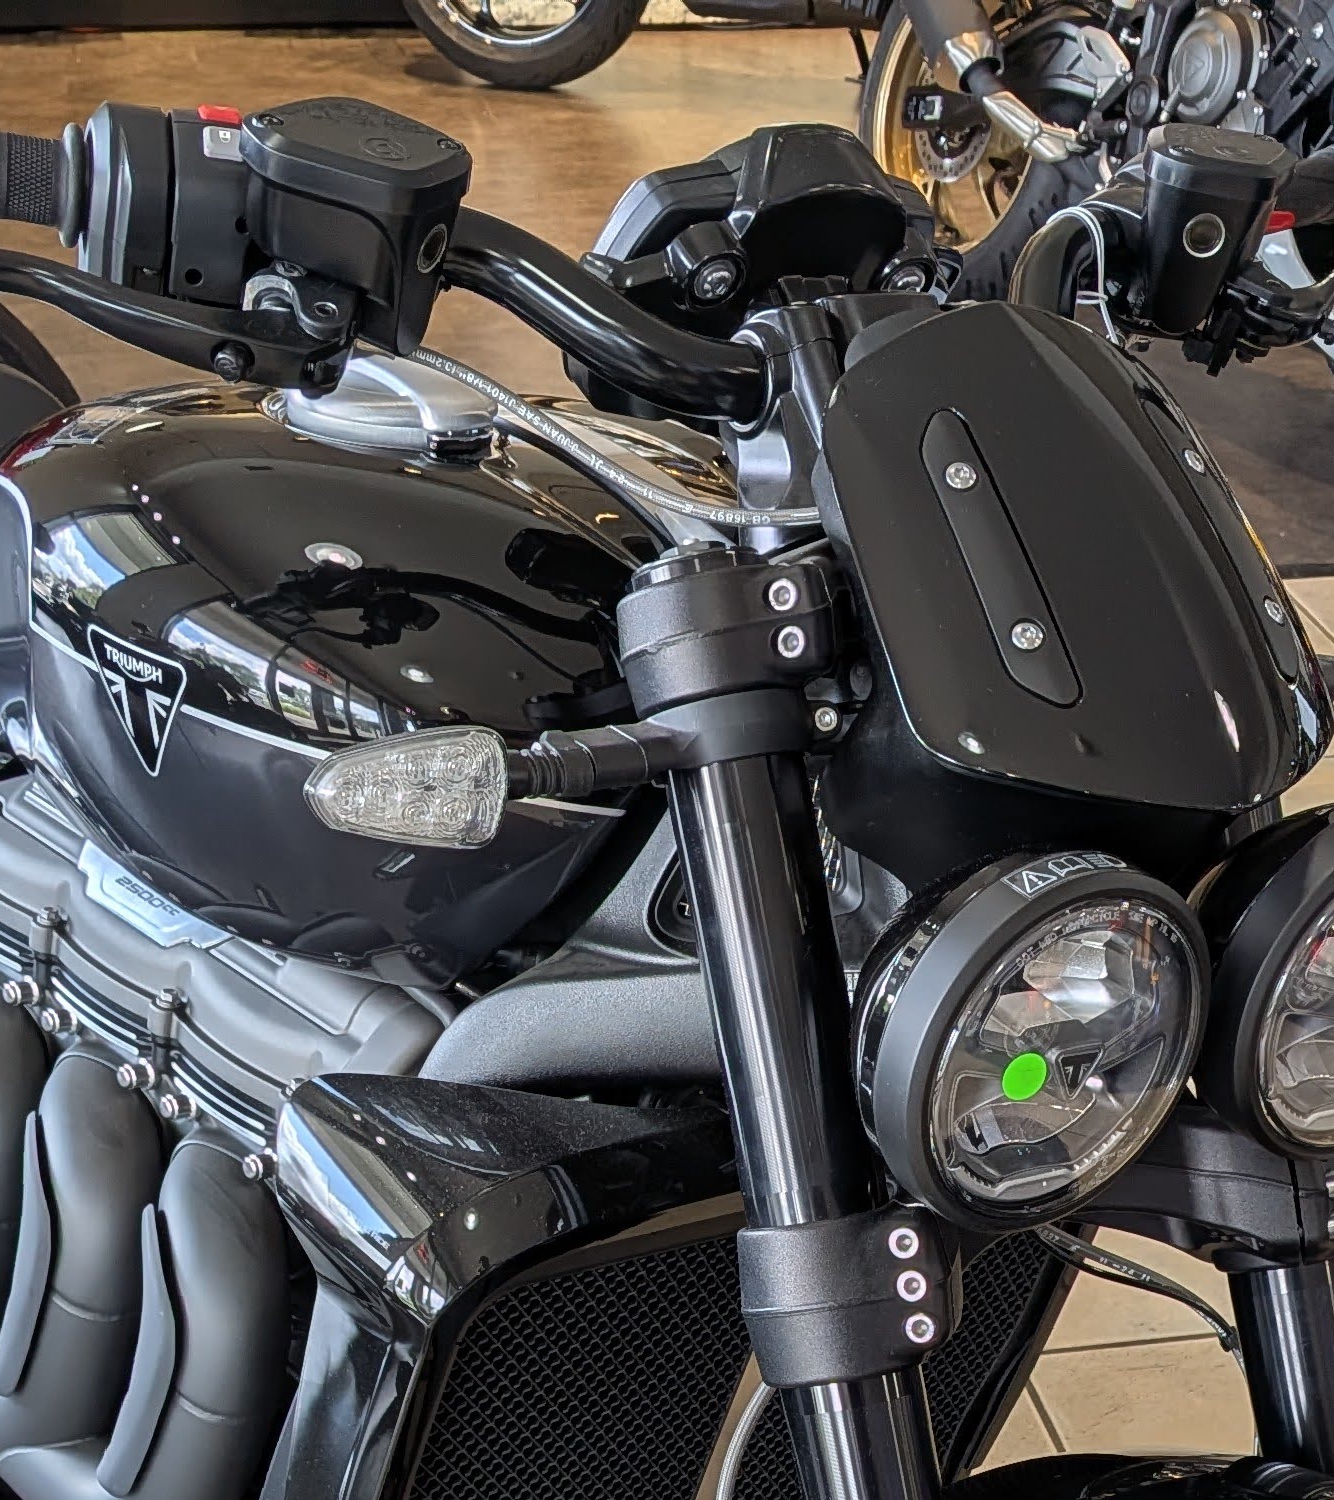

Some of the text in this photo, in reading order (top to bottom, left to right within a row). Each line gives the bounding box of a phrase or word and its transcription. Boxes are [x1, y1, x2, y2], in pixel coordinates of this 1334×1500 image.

[517, 406, 541, 426] SAE
[710, 510, 747, 523] 16897
[103, 642, 163, 685] TRIUMPH
[114, 876, 181, 917] 2500cc
